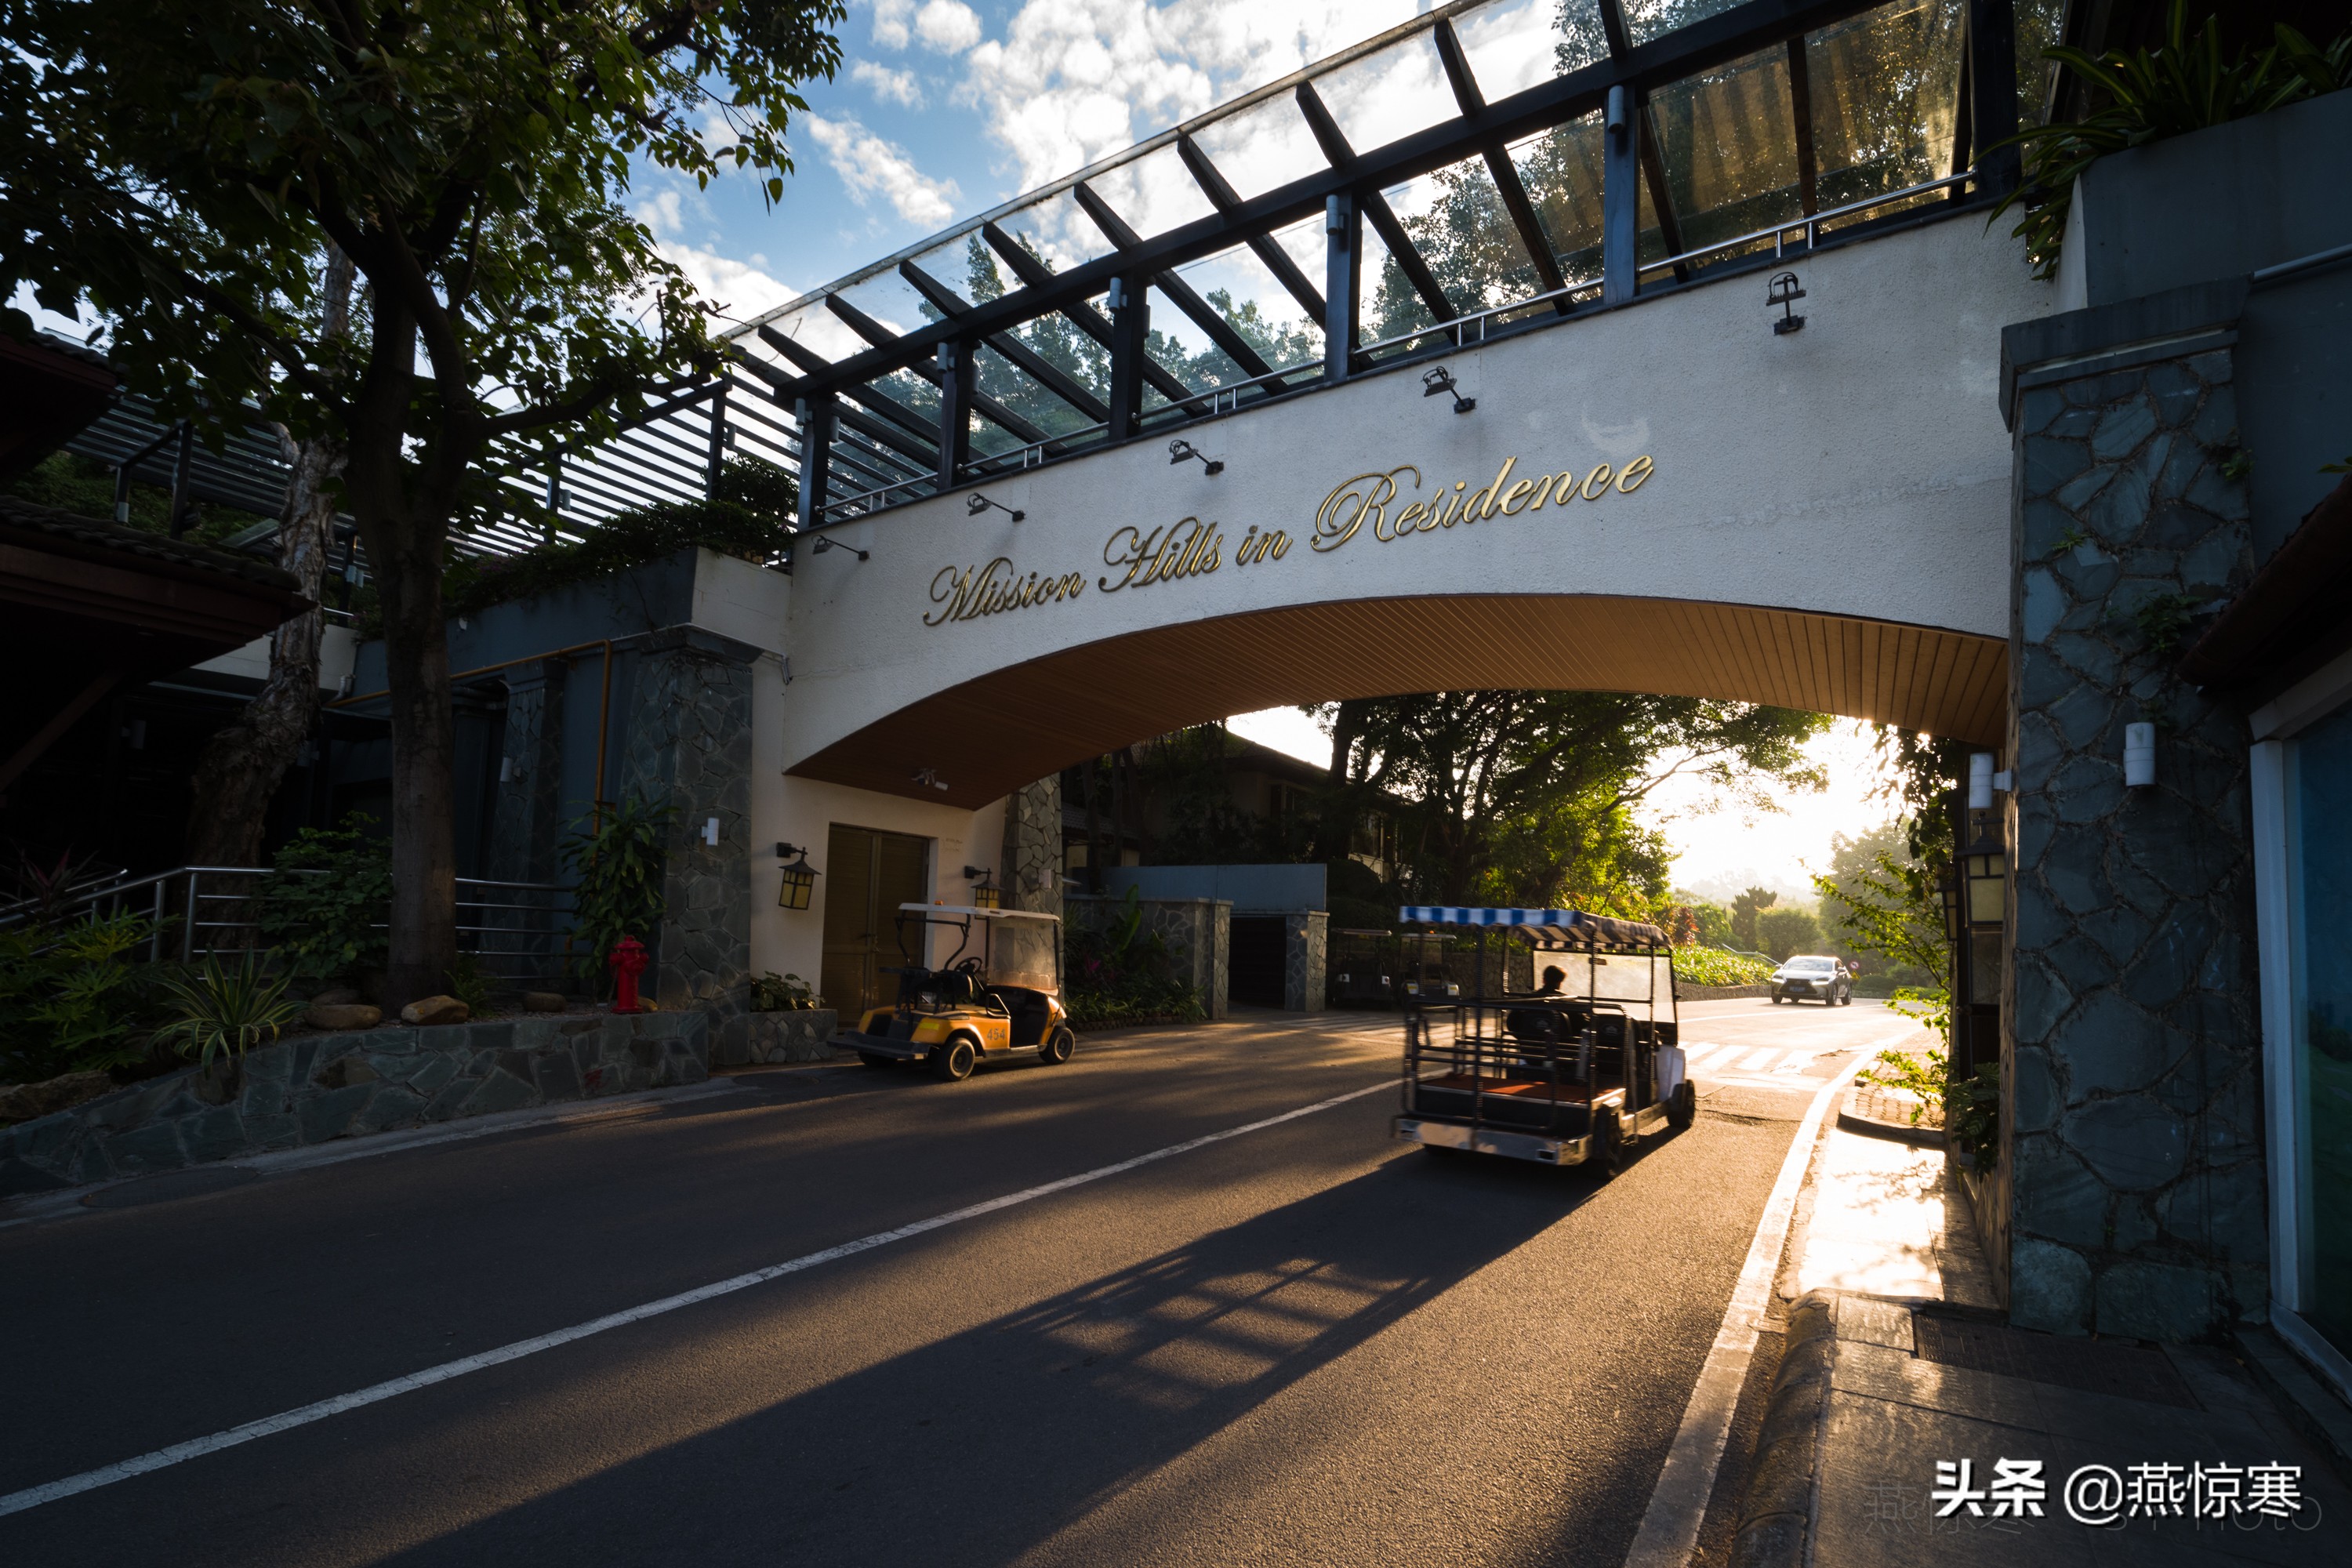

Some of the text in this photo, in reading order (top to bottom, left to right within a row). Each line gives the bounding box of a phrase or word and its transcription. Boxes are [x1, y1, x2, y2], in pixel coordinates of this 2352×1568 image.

[923, 454, 1653, 626] Mission Hills in Residence
[986, 1028, 1006, 1041] 454
